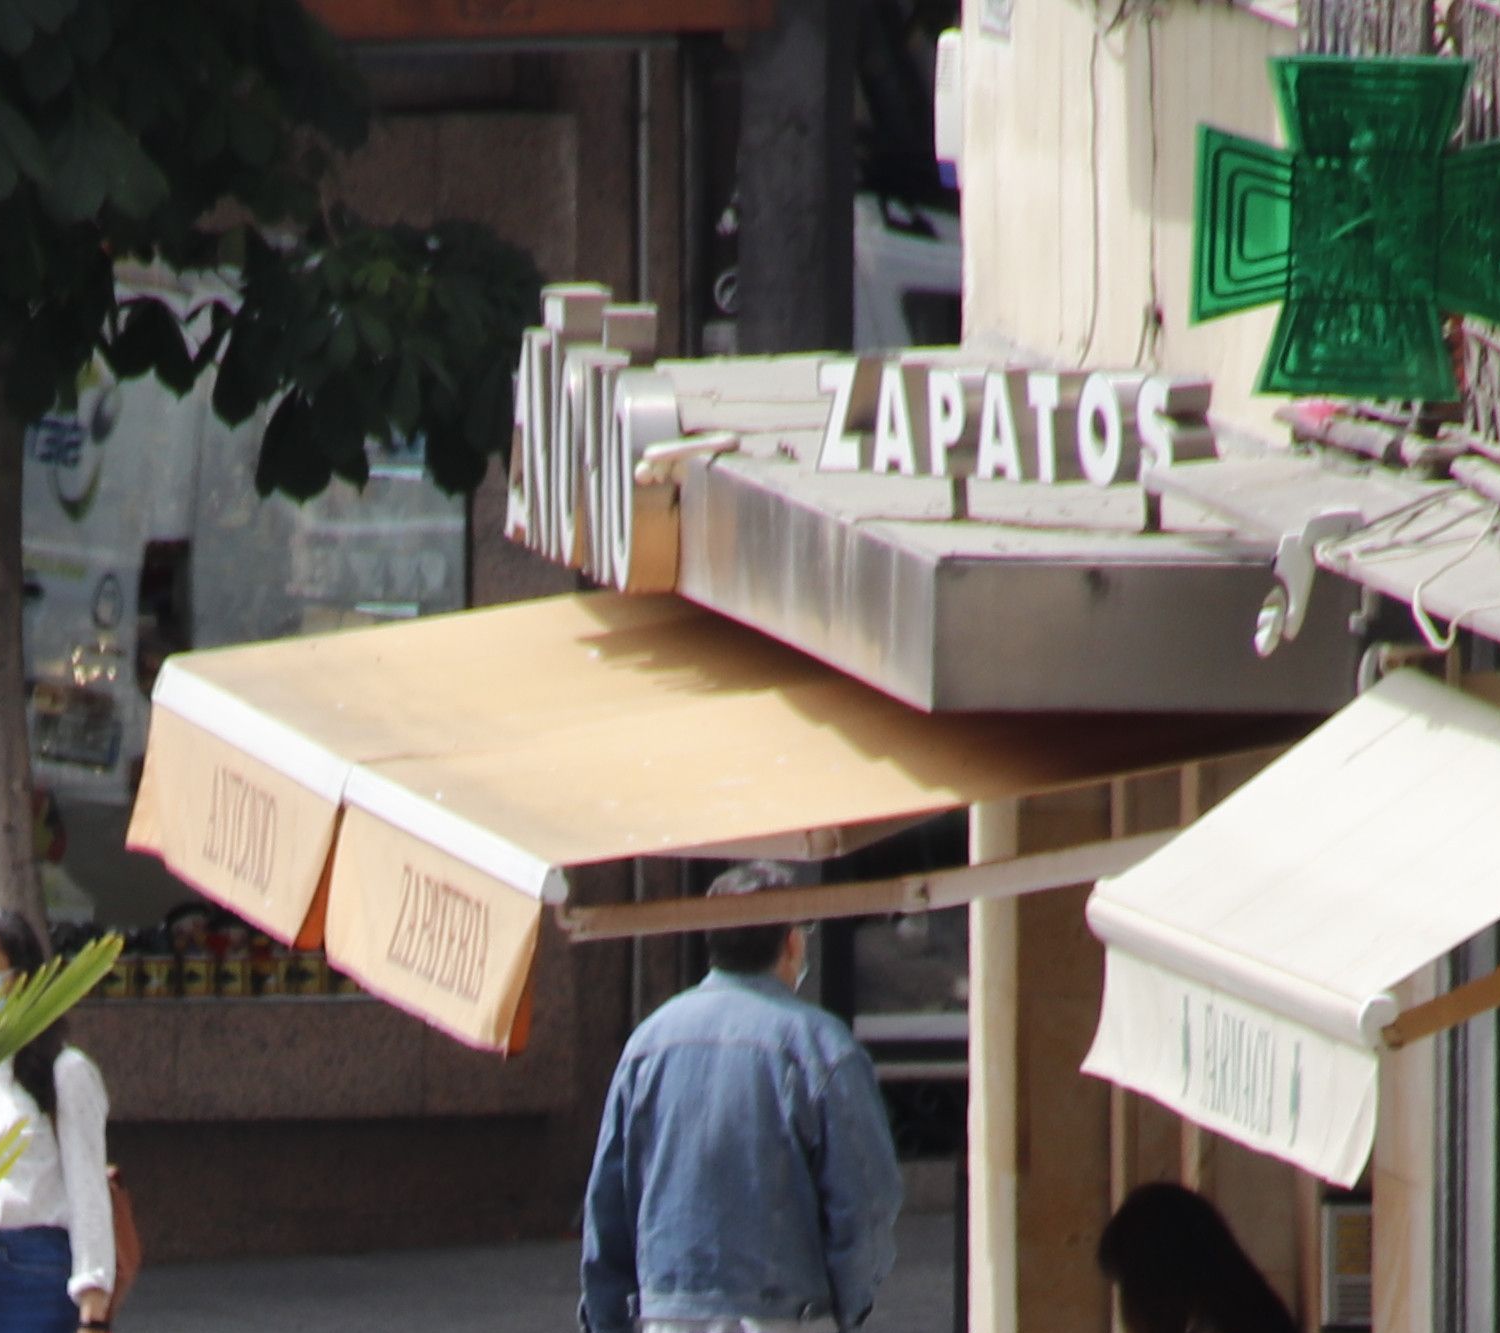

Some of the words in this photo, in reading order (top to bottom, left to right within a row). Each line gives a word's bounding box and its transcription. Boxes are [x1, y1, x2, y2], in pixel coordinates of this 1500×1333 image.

[816, 359, 1176, 487] ZAPATOS
[387, 863, 490, 1004] ZAPATERIA
[1200, 1001, 1276, 1136] FARMACIA
